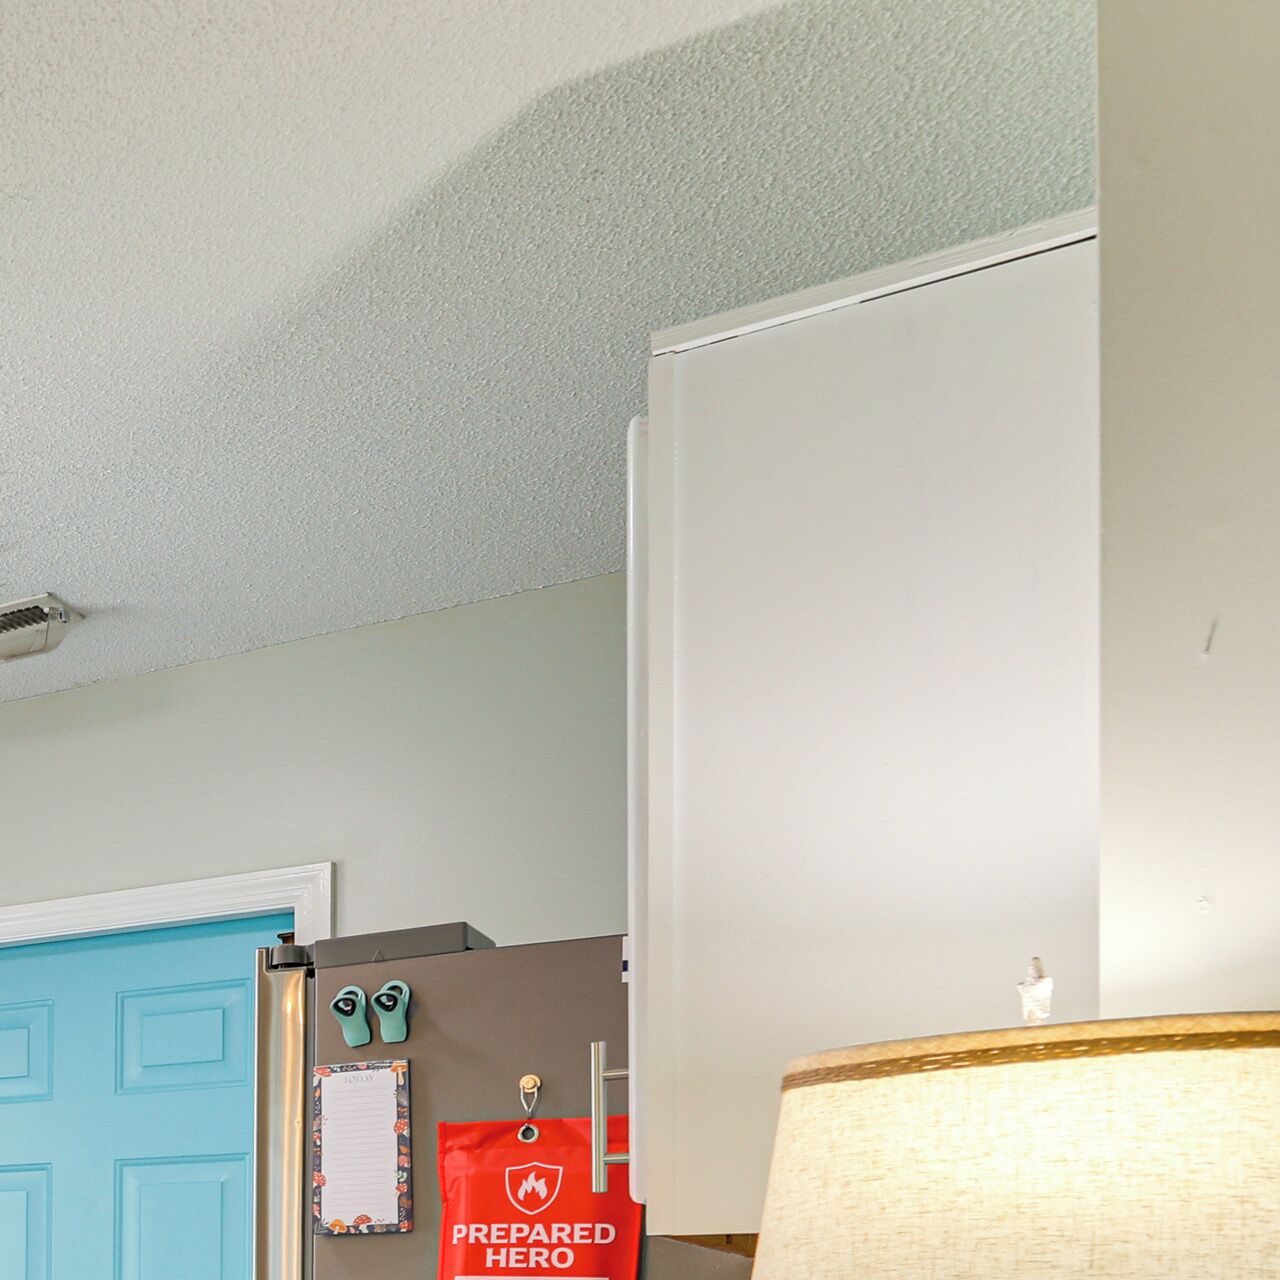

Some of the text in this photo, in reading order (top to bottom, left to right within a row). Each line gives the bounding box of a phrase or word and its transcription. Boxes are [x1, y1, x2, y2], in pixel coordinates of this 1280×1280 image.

[344, 1074, 374, 1084] TODAY
[451, 1222, 616, 1245] PREPARED
[484, 1246, 575, 1269] HERO
